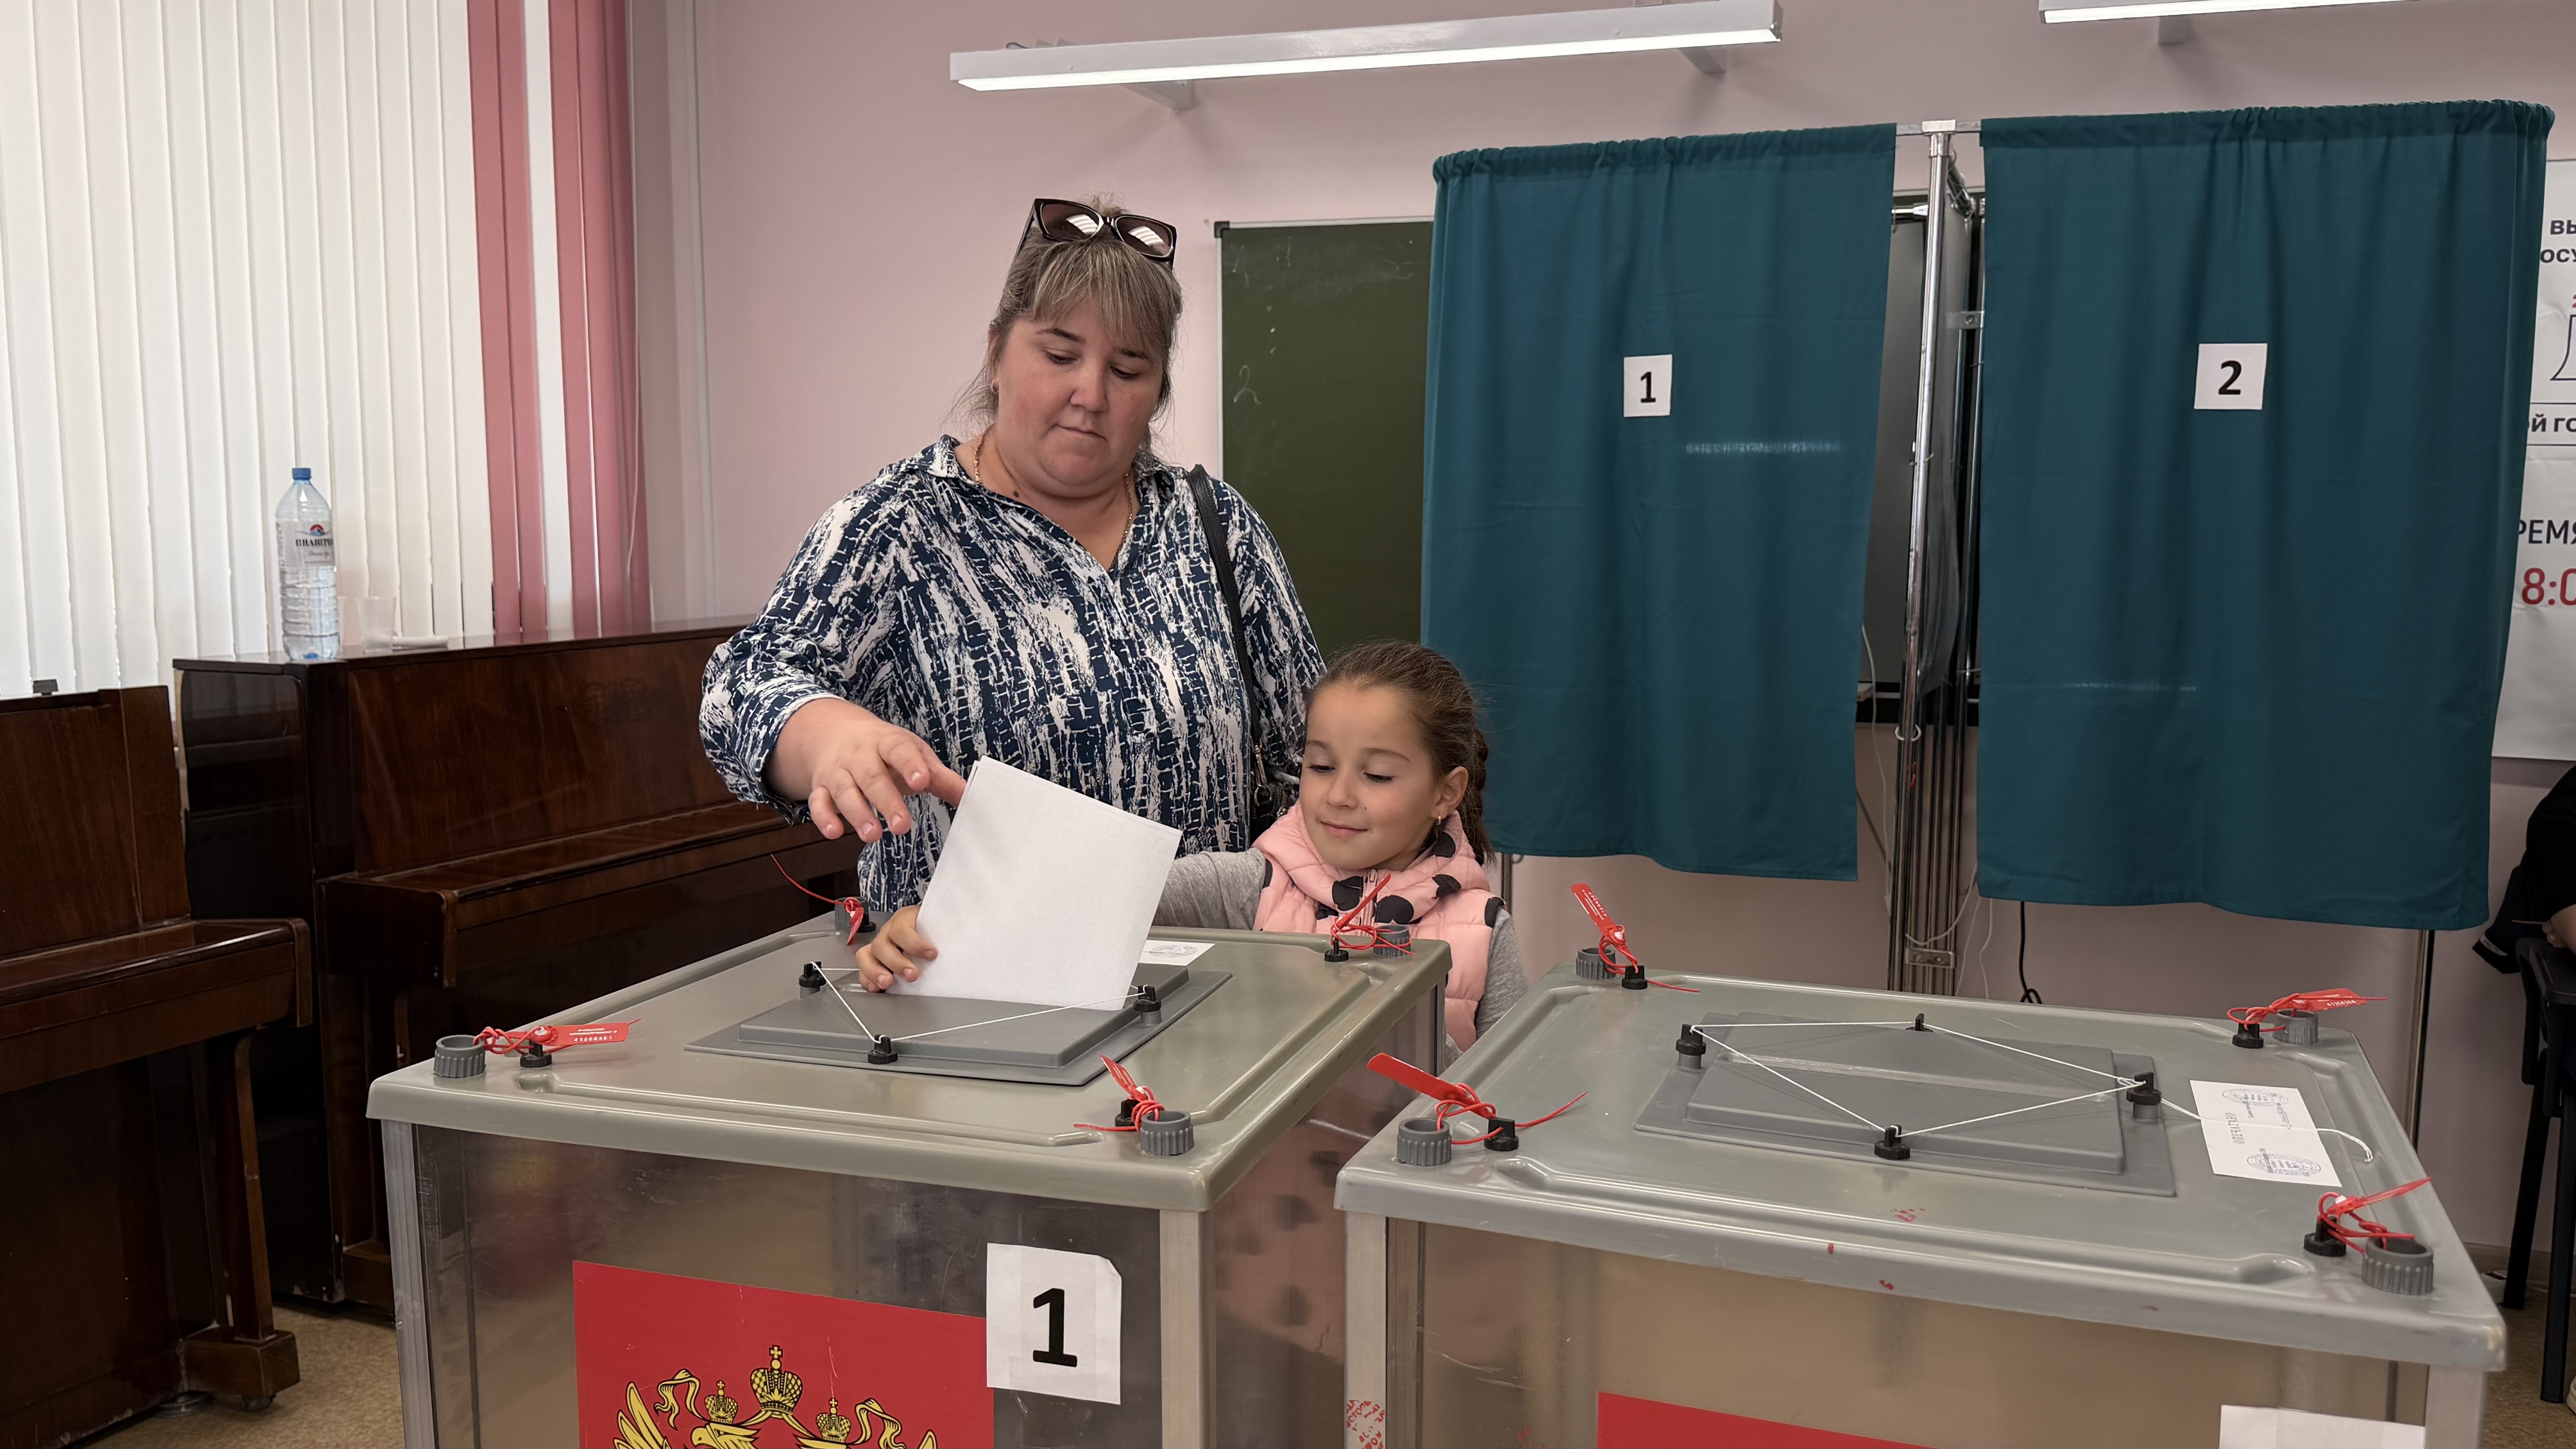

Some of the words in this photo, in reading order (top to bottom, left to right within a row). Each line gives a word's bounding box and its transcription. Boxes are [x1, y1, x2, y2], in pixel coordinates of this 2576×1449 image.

[1640, 372, 1656, 403] 1
[2218, 360, 2241, 395] 2
[2529, 414, 2546, 432] Й
[2522, 568, 2576, 606] 8:0
[1033, 1288, 1077, 1367] 1
